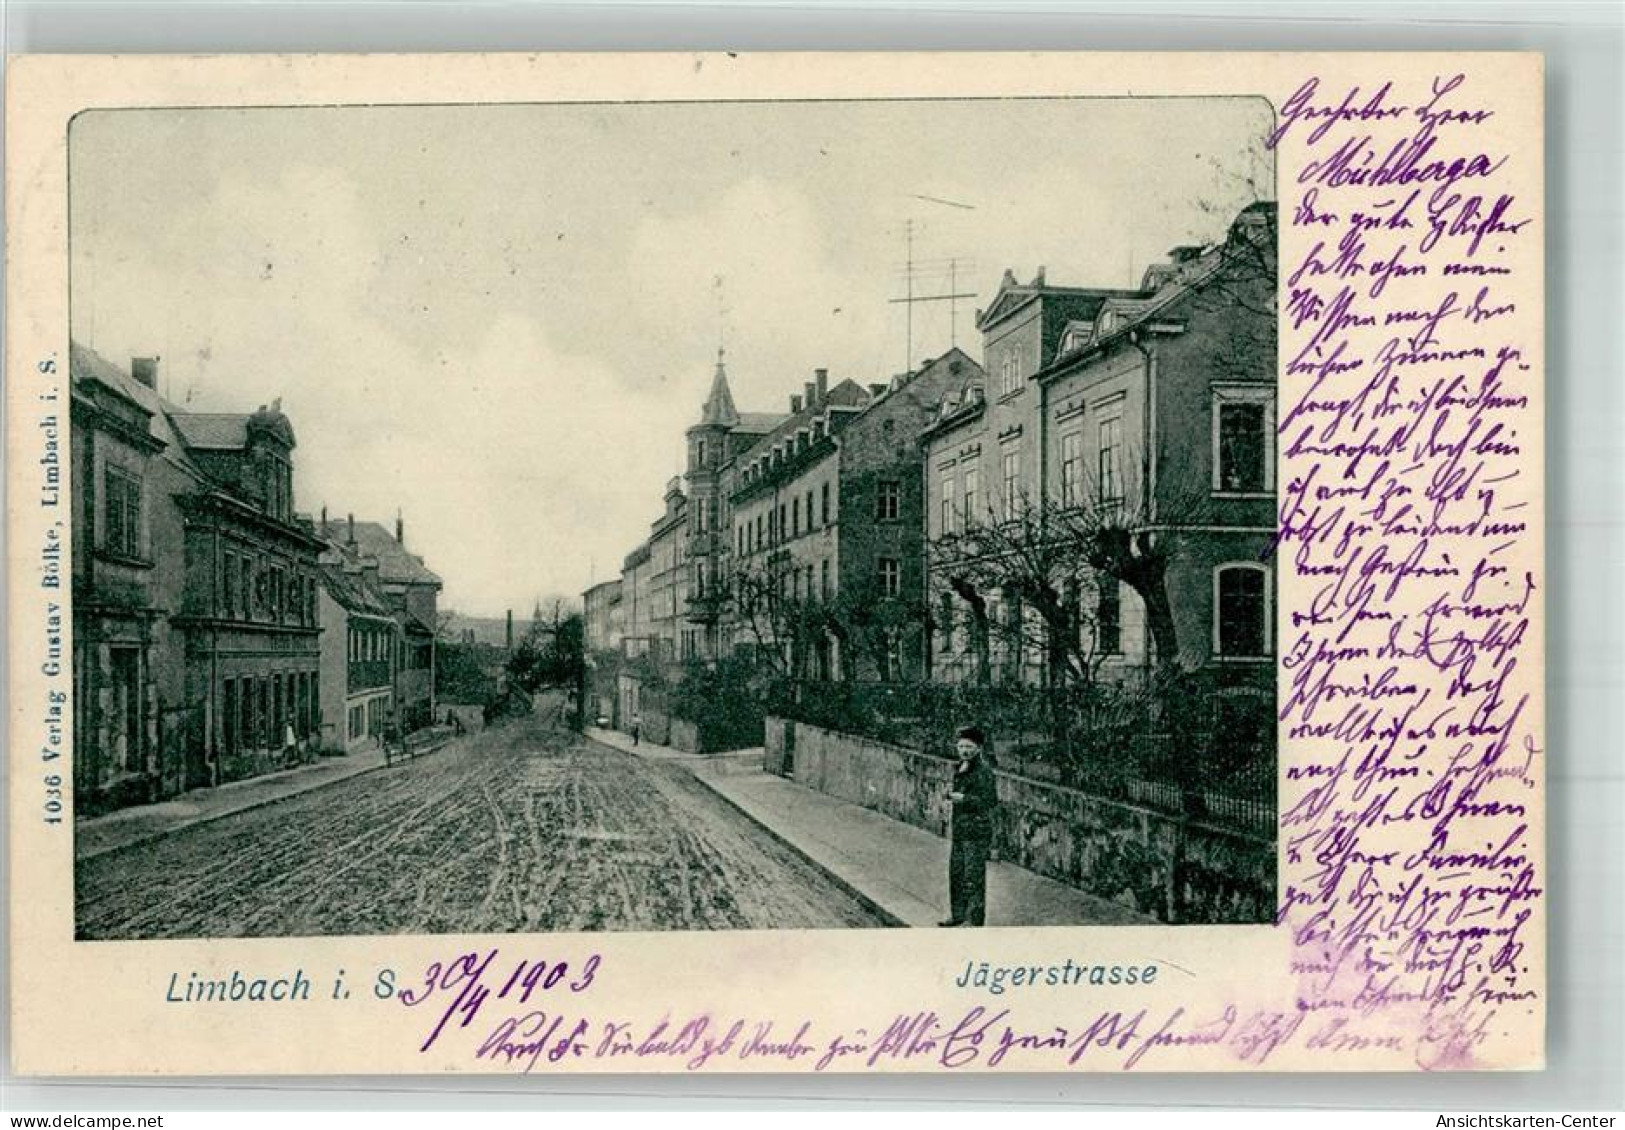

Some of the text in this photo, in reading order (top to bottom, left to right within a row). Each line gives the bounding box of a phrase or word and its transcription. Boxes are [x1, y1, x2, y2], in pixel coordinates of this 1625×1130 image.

[37, 351, 66, 824] 1036 Verlag Gustav Bölke, Limbach i. S.
[166, 968, 311, 1003] Limbach
[332, 970, 351, 1001] i.
[497, 954, 602, 1004] 1903
[955, 959, 1158, 995] Jägerstrasse
